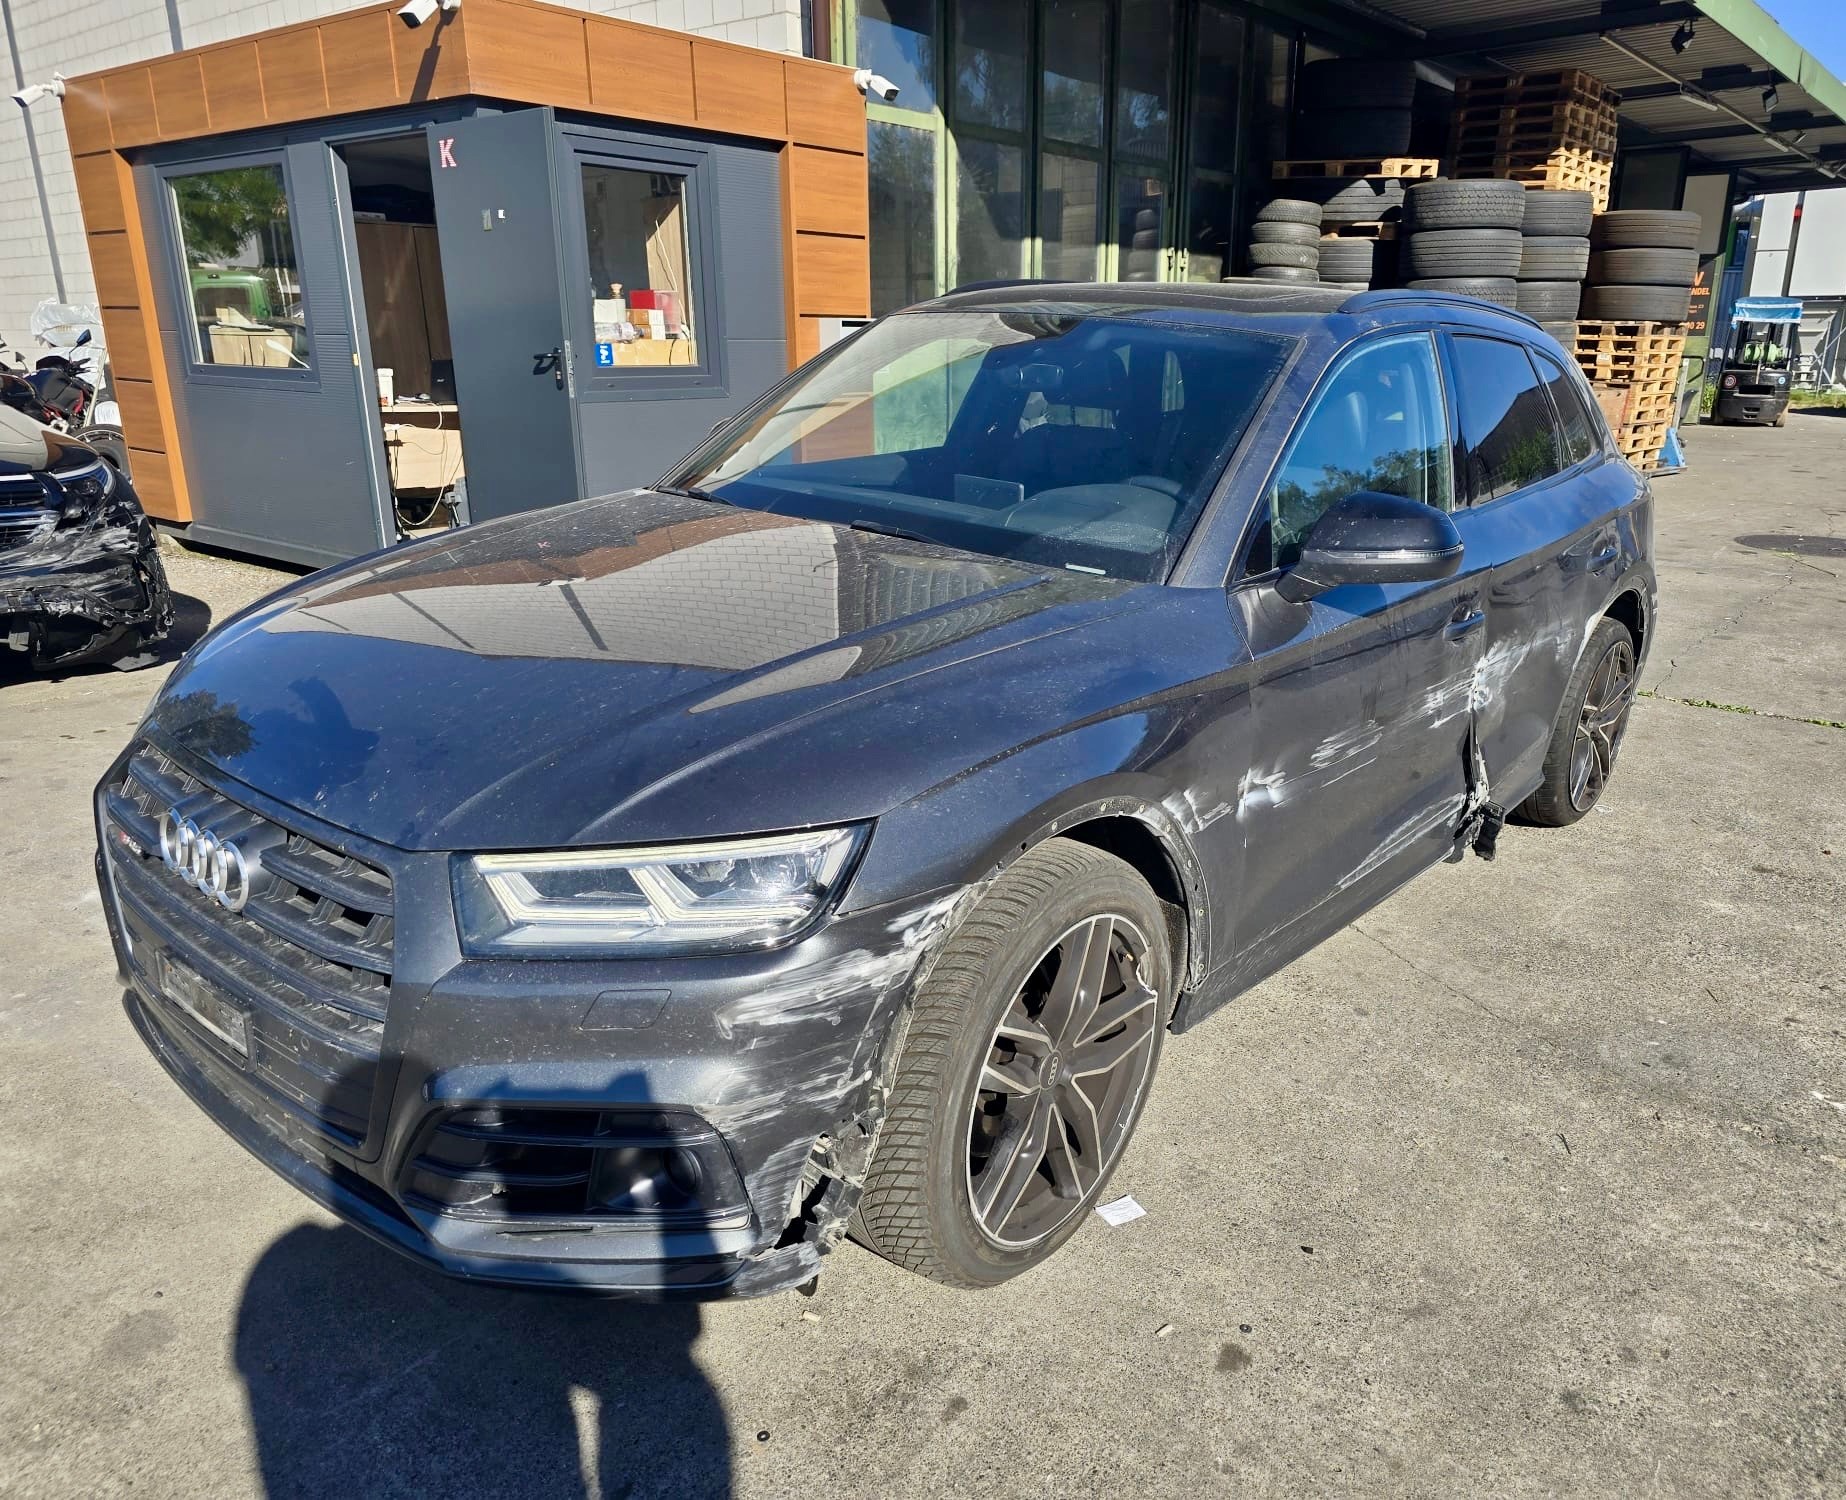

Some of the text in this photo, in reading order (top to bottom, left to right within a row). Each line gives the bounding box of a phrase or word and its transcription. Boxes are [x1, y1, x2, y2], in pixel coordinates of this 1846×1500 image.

[438, 138, 457, 168] K
[1691, 287, 1710, 296] NDEL
[1695, 321, 1705, 330] 29
